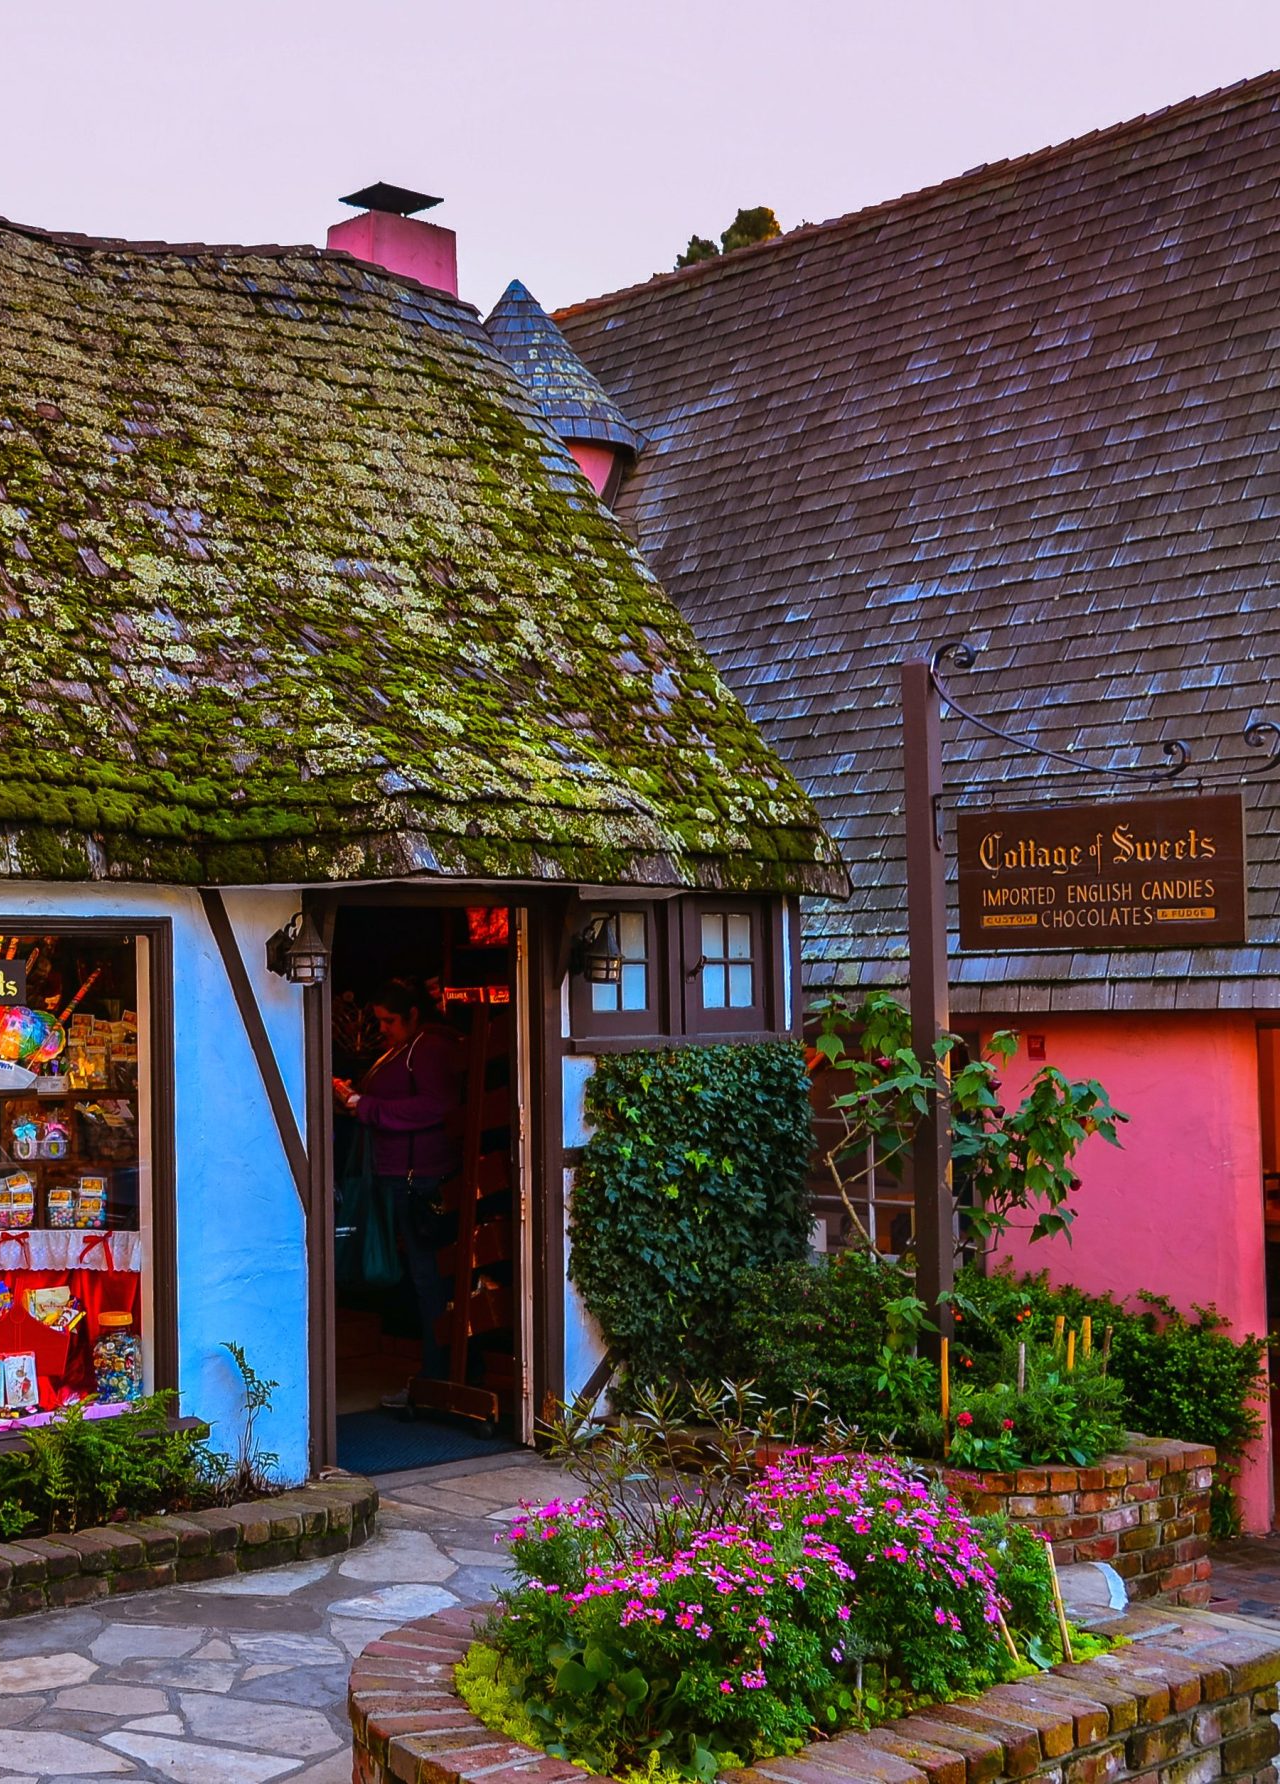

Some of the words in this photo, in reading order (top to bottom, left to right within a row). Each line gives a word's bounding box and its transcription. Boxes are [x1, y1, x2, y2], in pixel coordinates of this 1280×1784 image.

[979, 831, 1083, 880] Cottage
[1088, 832, 1104, 877] of
[1111, 823, 1217, 865] Sweets
[982, 887, 1056, 907] IMPORTED
[1067, 883, 1132, 904] ENGLISH
[1141, 879, 1215, 901] CANDIES
[1040, 906, 1154, 928] CHOCOLATES
[1171, 908, 1208, 918] FUDGE
